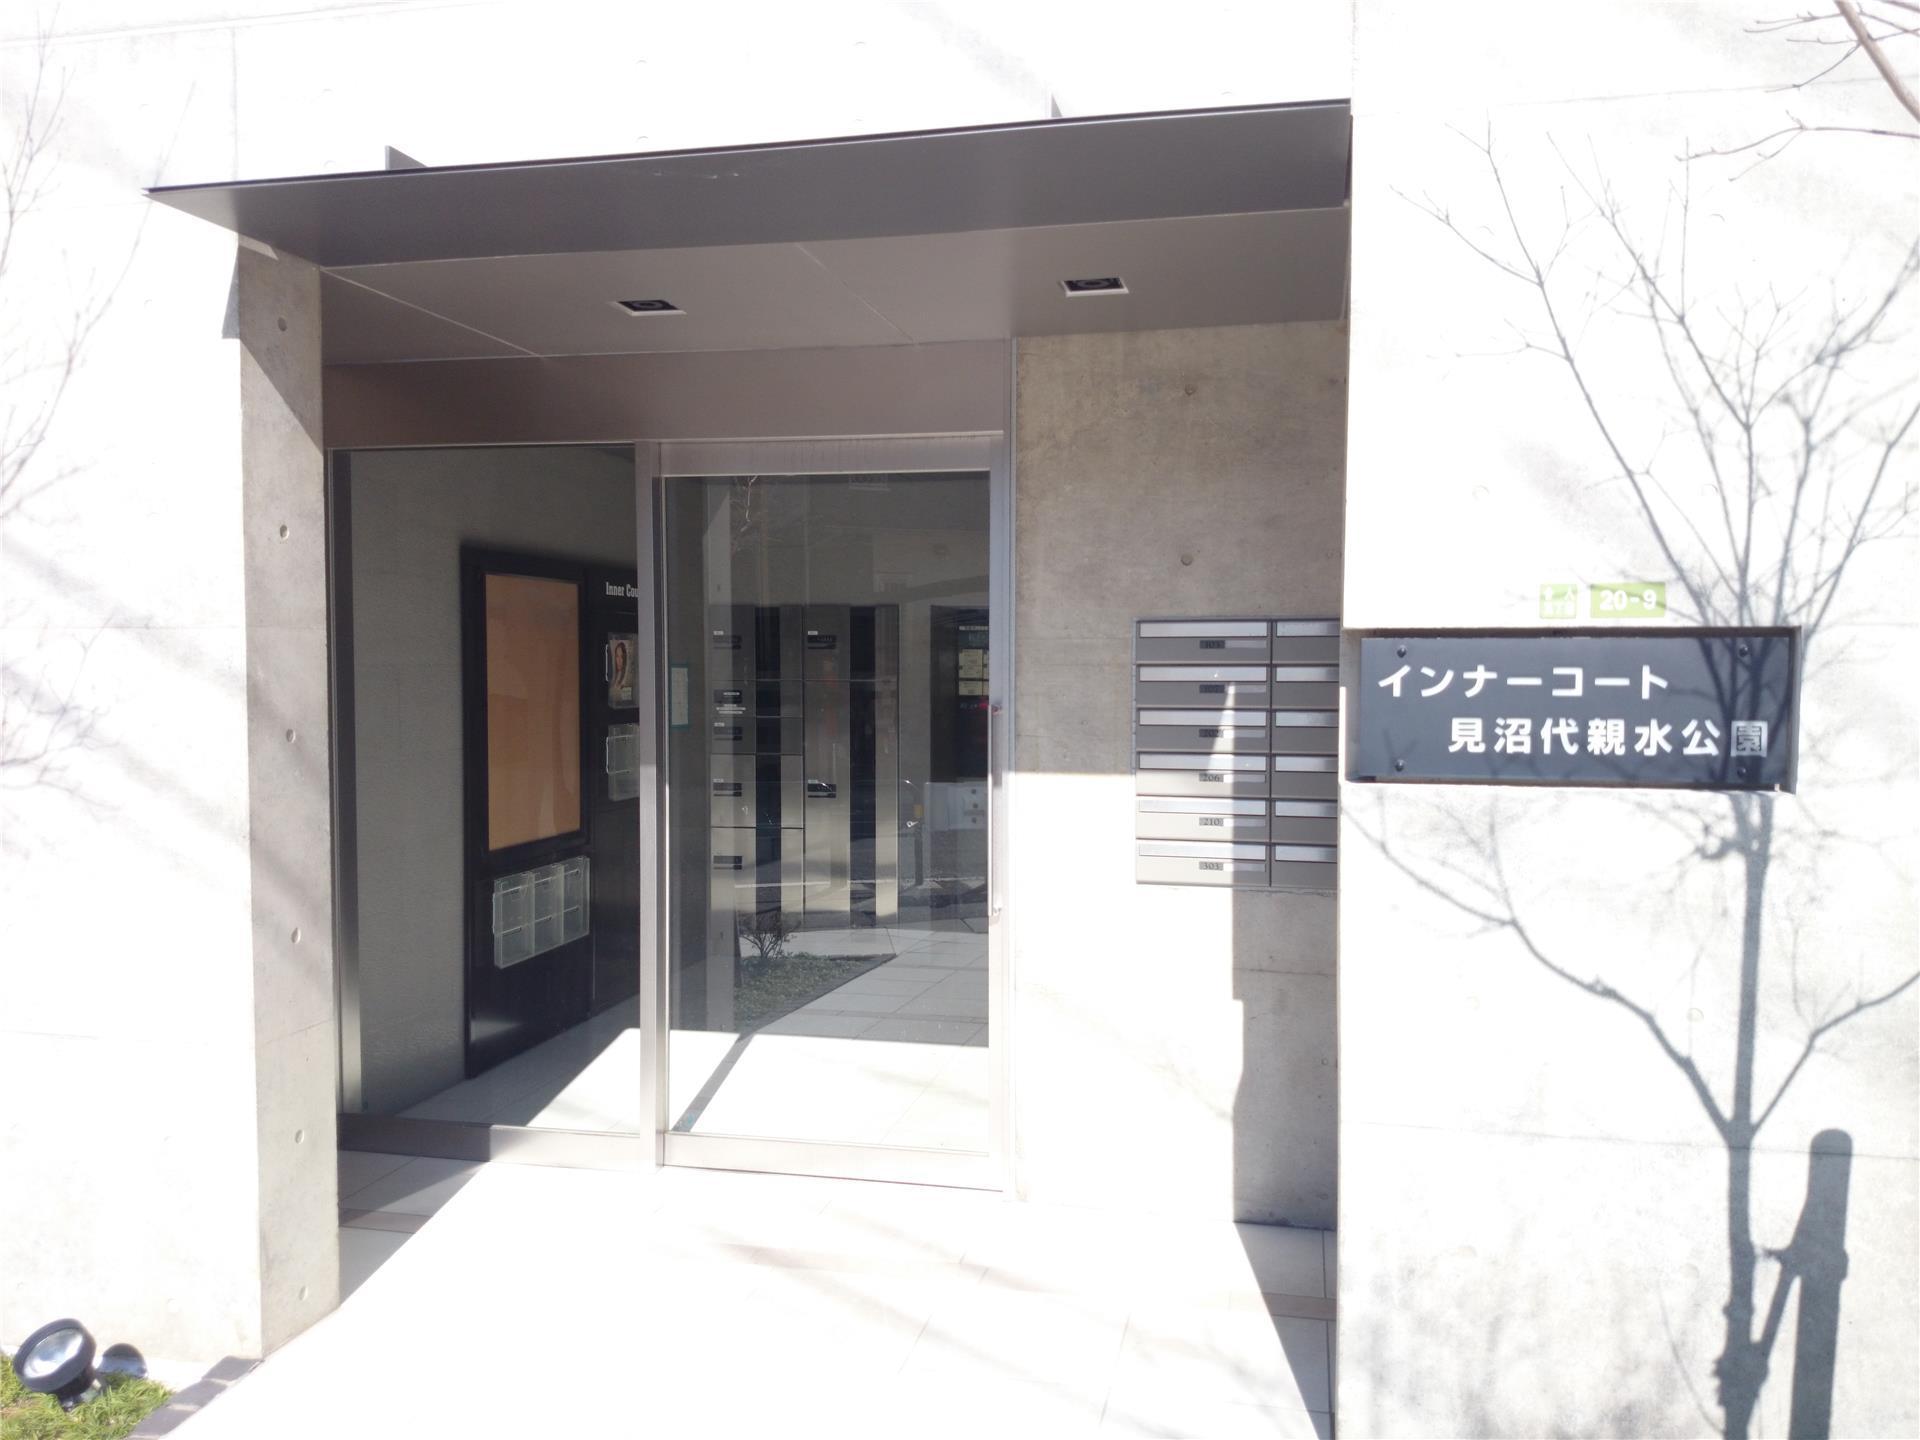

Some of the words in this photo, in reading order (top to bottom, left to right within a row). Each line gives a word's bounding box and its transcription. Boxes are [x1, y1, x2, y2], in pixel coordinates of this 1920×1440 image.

[606, 581, 624, 597] Inner
[1600, 589, 1657, 610] 20-9
[1378, 664, 1668, 700] インナーコート
[1448, 717, 1768, 757] 見沼代親水公園
[1204, 772, 1220, 782] 206
[1204, 817, 1220, 826] 210
[1203, 861, 1219, 870] 303
